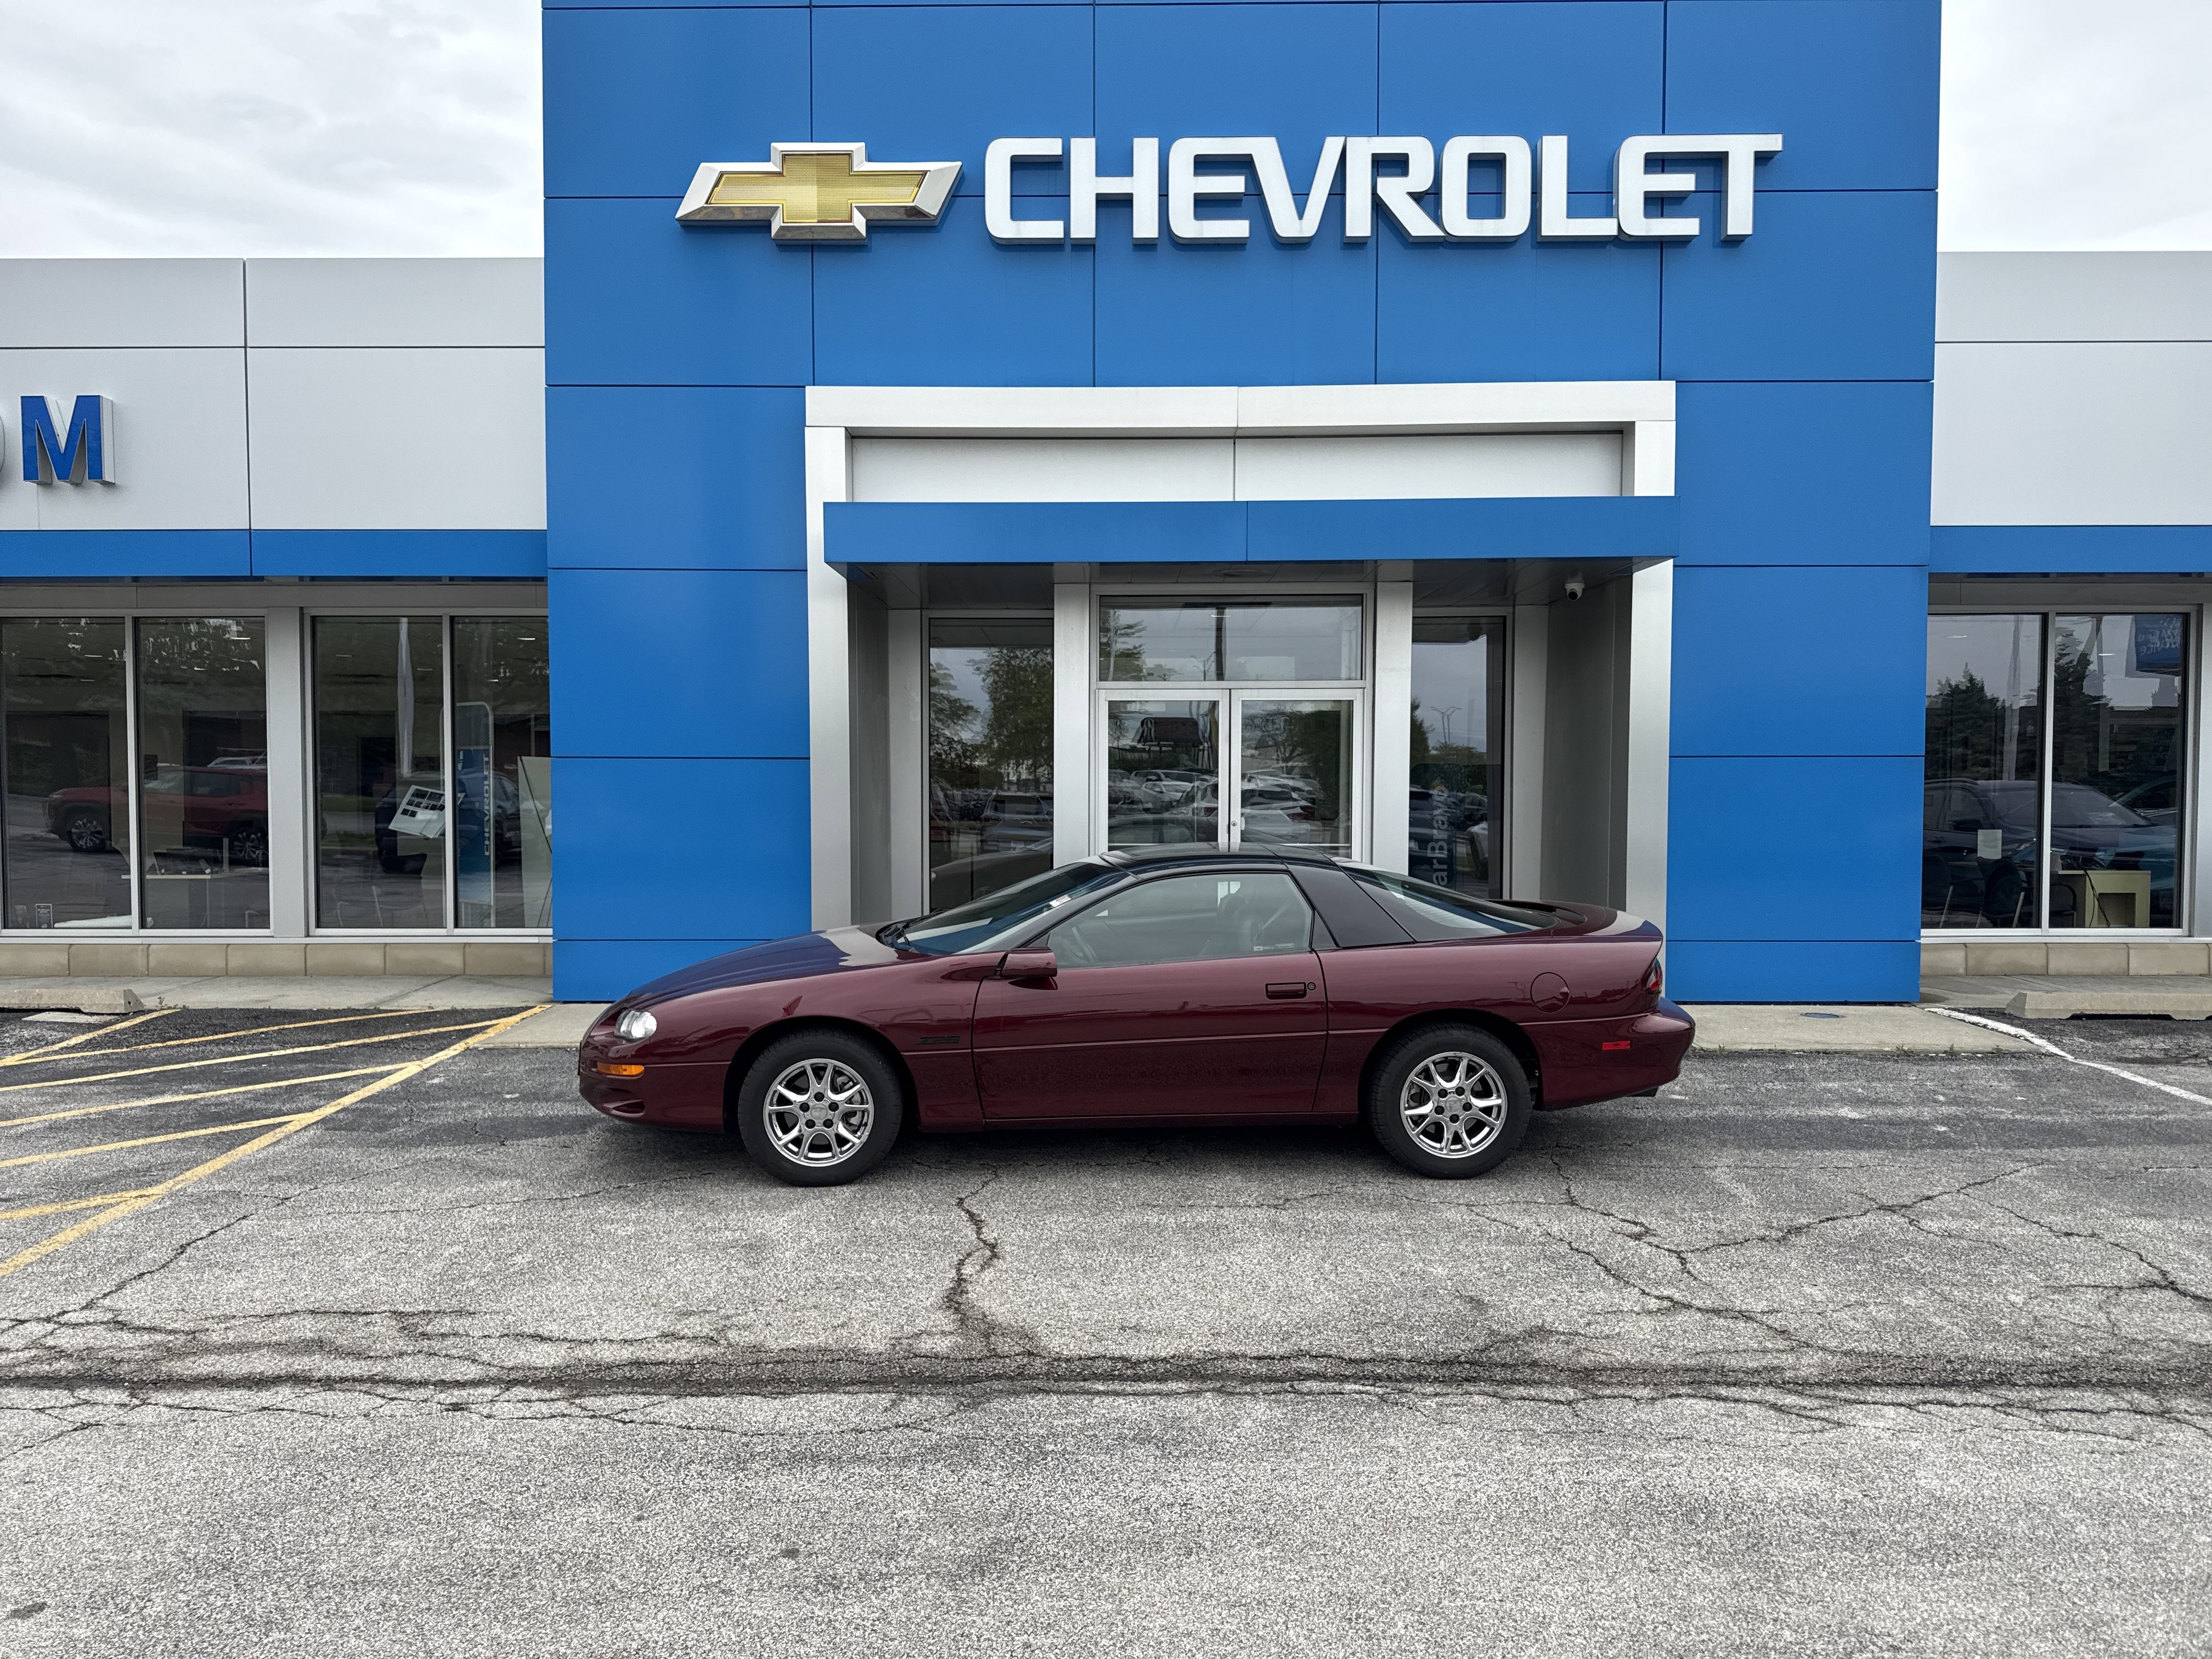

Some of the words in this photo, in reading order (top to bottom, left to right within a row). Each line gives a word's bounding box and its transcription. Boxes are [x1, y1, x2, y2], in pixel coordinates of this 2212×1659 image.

[985, 133, 1784, 242] CHEVROLET
[0, 394, 110, 483] M
[1427, 785, 1448, 886] arBravo
